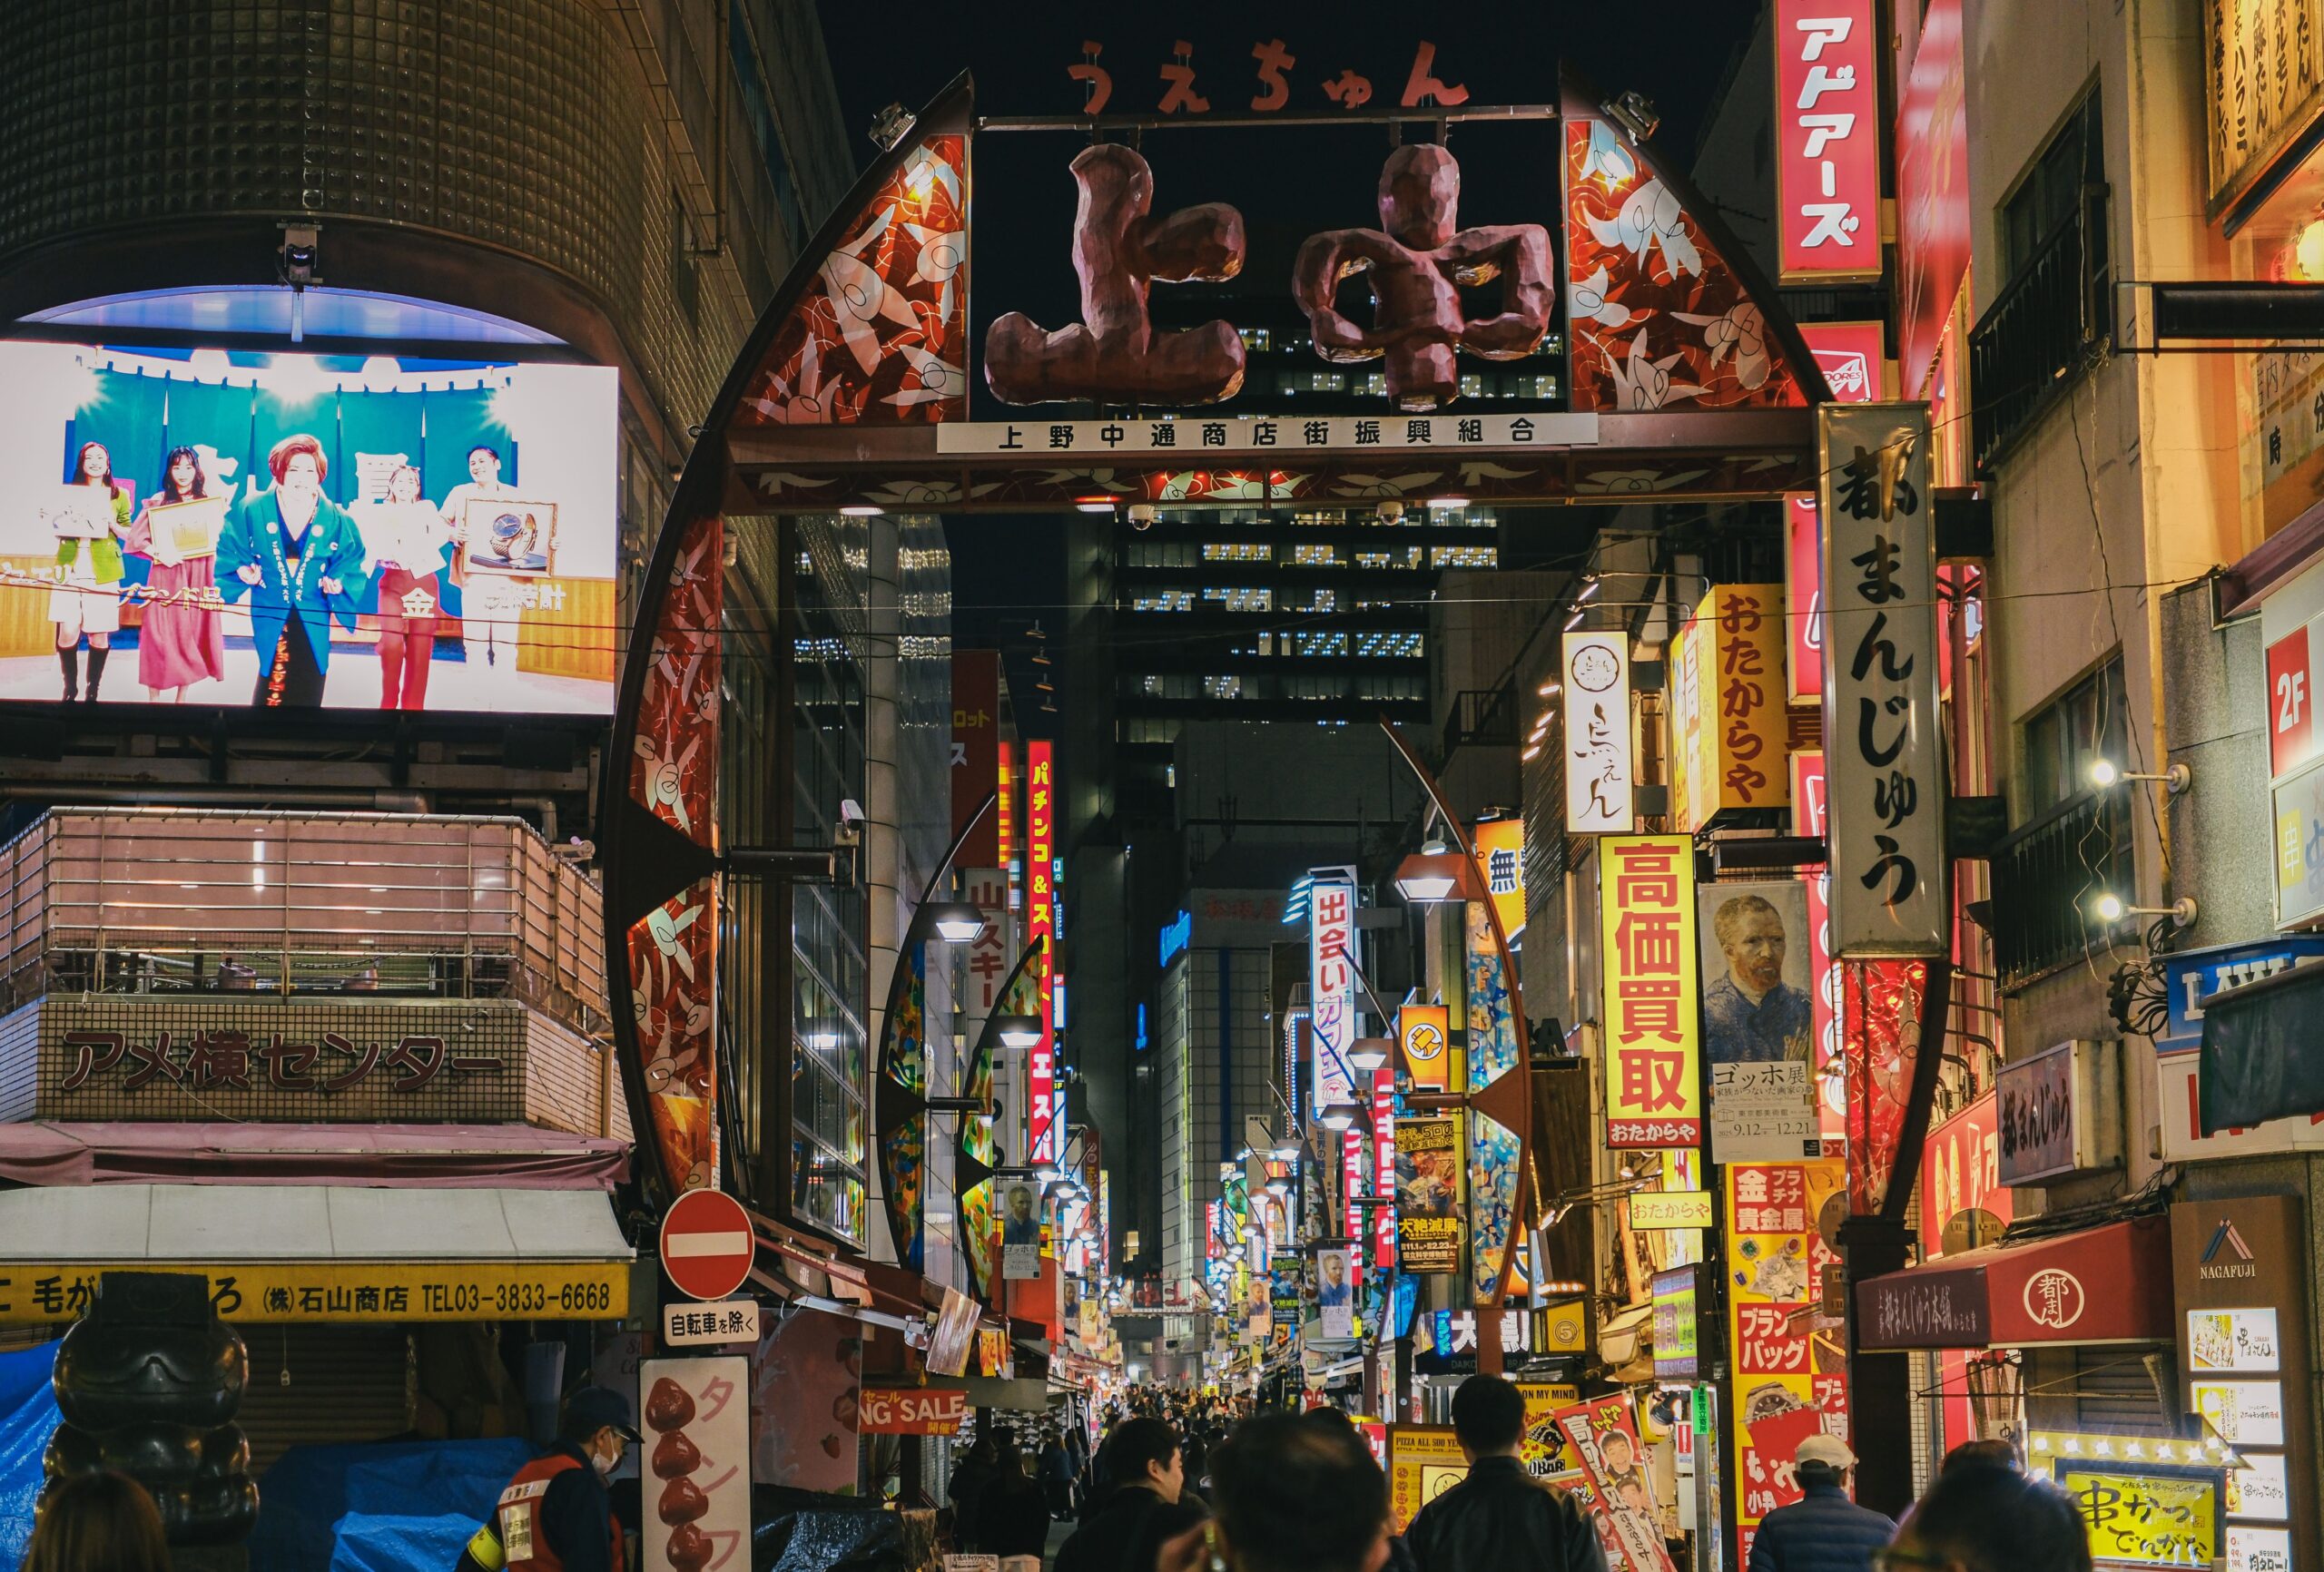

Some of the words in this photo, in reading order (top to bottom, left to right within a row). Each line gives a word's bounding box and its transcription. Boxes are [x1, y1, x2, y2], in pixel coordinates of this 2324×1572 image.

[1068, 39, 1469, 115] うえちゅん
[1797, 17, 1859, 247] アドアーズ
[1821, 371, 1861, 383] DORES
[999, 418, 1536, 450] 上野中通商店街振興組合
[118, 582, 226, 611] ブランド品
[400, 587, 436, 618] 金
[1836, 447, 1918, 906] 都まんじゅう
[1721, 593, 1767, 804] おたからや
[2277, 670, 2304, 733] 2F
[2284, 820, 2300, 878] 串
[1614, 843, 1688, 1113] 高価買取
[63, 1029, 504, 1090] アメ横センター
[1715, 1063, 1806, 1089] ゴッホ展
[1611, 1123, 1697, 1142] おたからや
[1733, 1123, 1761, 1136] 9.12
[1777, 1122, 1810, 1135] 12.21
[1738, 1169, 1768, 1203] 金
[1772, 1169, 1800, 1182] プラ
[1772, 1189, 1802, 1204] チナ
[1399, 1217, 1457, 1233] 大絶滅展
[1633, 1203, 1710, 1219] おたからや
[1737, 1208, 1804, 1232] 貴金属
[2201, 1264, 2256, 1280] NAGAFUJI
[262, 1280, 409, 1316] (株)石山商店
[422, 1282, 611, 1312] TEL03-3833-6668
[671, 1311, 755, 1337] 自転車を除く
[1741, 1308, 1791, 1339] ブラン
[1741, 1339, 1807, 1371] バッグ
[863, 1390, 901, 1404] セール
[900, 1395, 966, 1422] SALE
[1537, 1390, 1550, 1400] MY
[1552, 1390, 1575, 1400] MIND
[1395, 1437, 1415, 1447] PIZZA
[1418, 1438, 1431, 1447] ALL
[698, 1375, 743, 1572] タンフ
[2074, 1480, 2191, 1529] 串かつ
[2107, 1525, 2208, 1559] でんがな
